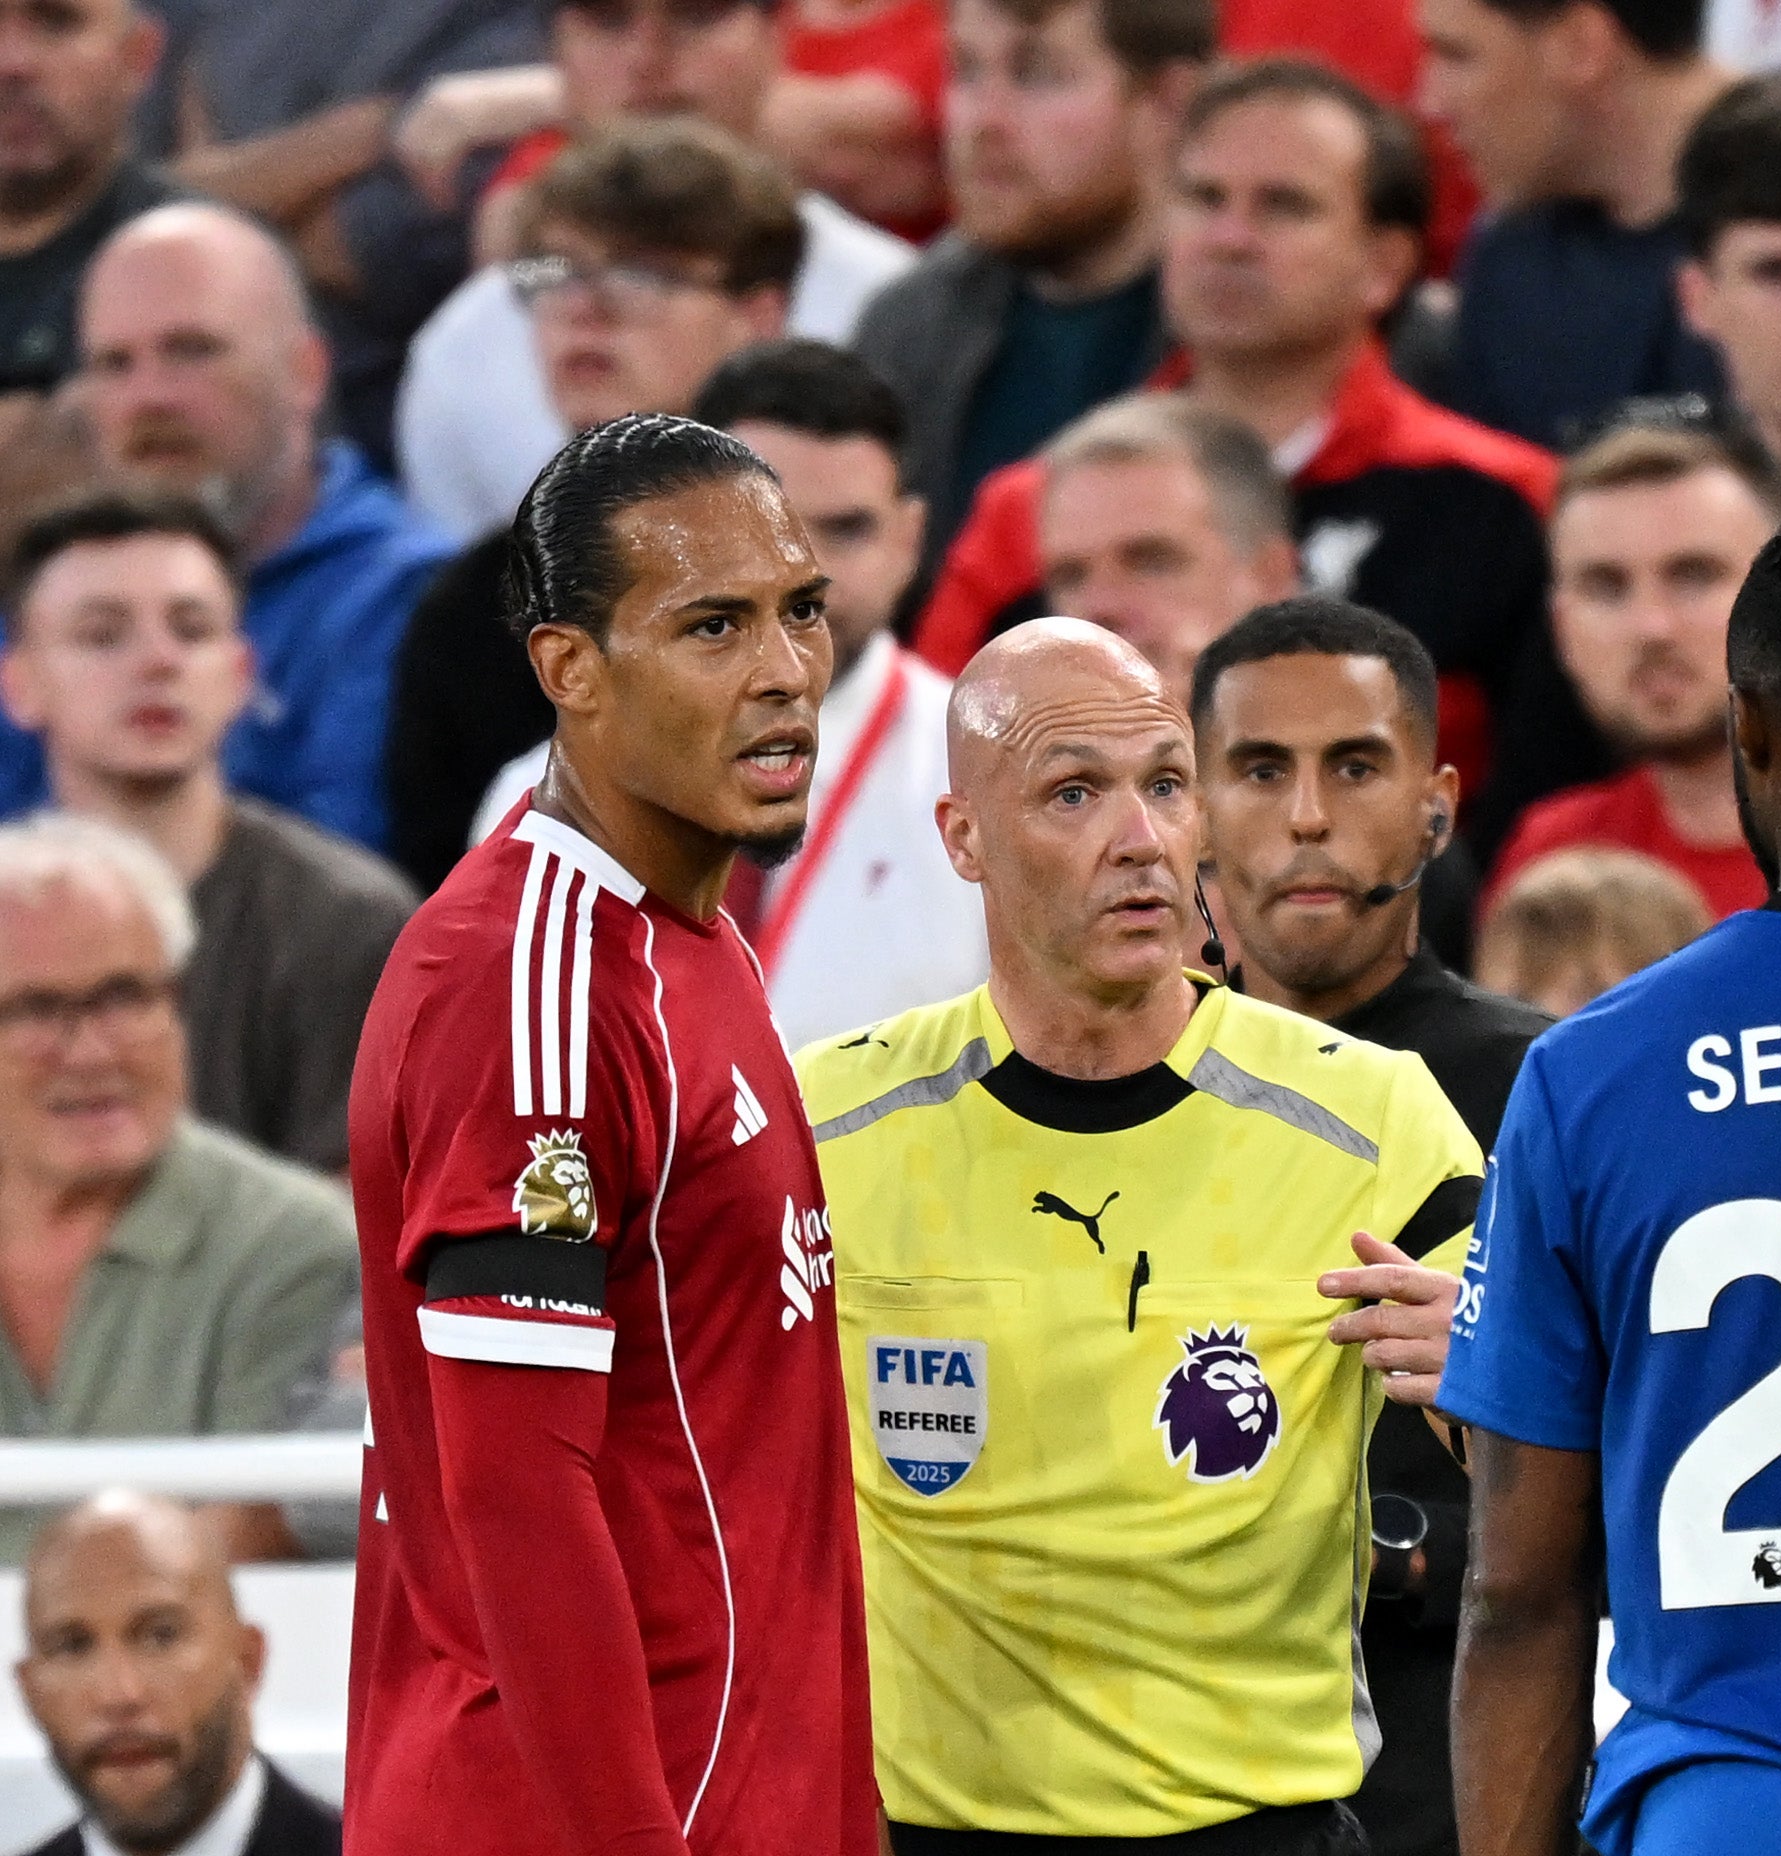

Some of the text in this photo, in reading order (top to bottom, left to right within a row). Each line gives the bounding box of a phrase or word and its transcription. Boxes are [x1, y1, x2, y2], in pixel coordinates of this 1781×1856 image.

[876, 1347, 976, 1388] FIFA
[879, 1410, 977, 1434] REFEREE
[907, 1465, 950, 1483] 2025
